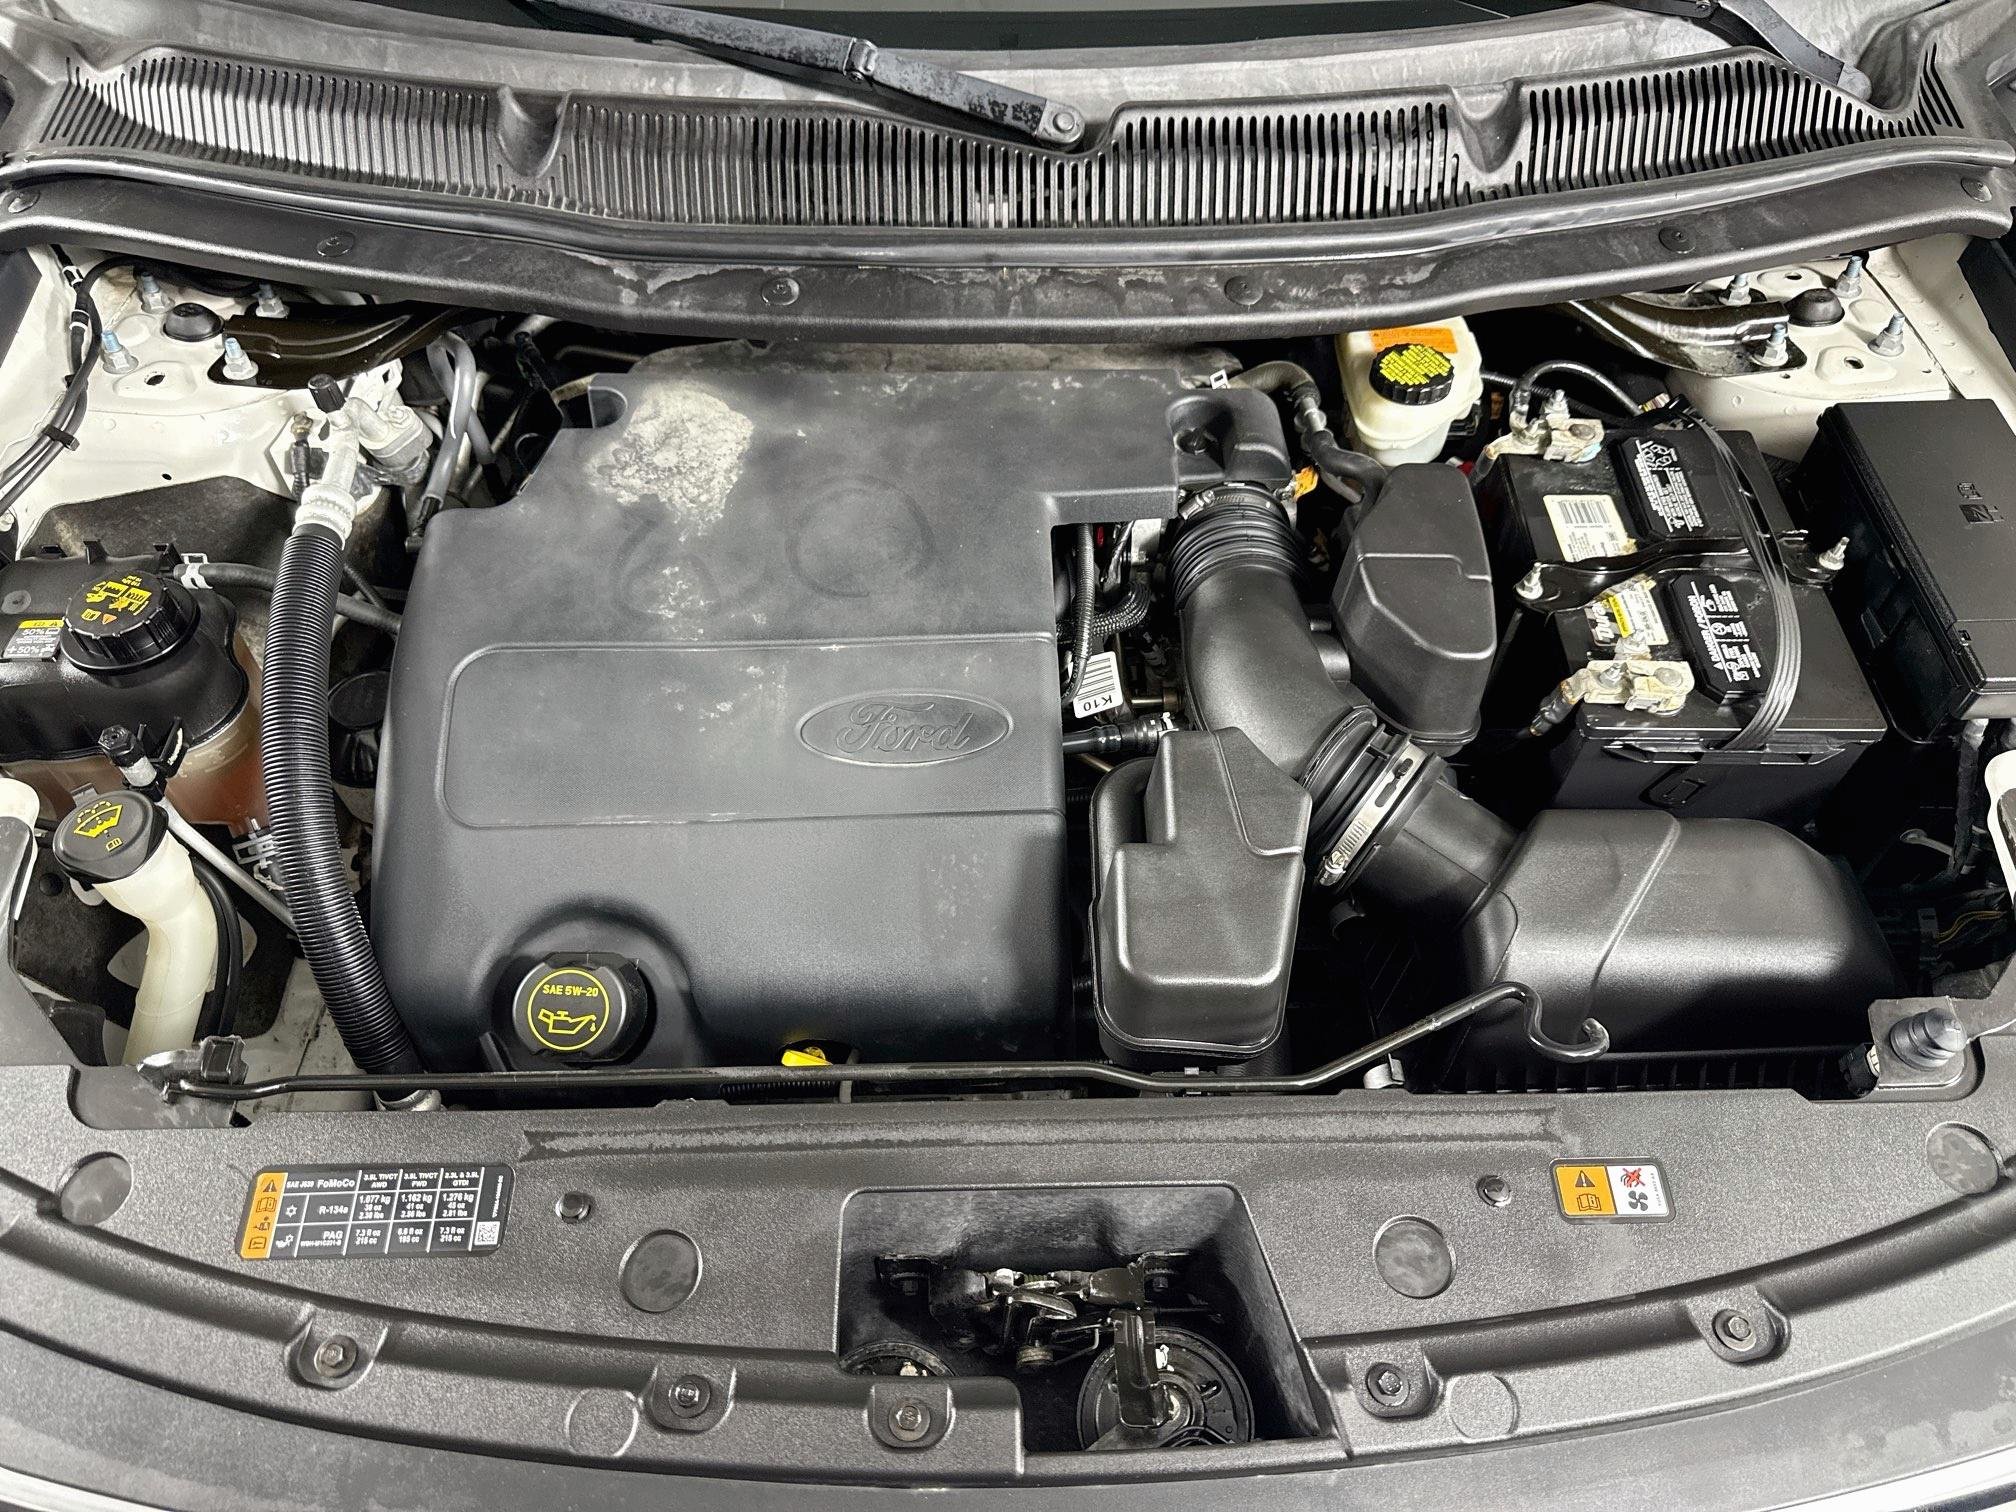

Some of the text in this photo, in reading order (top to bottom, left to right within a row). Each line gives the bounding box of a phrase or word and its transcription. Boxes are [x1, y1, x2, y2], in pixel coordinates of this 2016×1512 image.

[1687, 594, 1706, 623] POISON
[22, 628, 45, 636] 50%
[1701, 629, 1720, 662] DANGER
[1083, 694, 1113, 712] K10
[836, 701, 975, 754] Ford
[542, 984, 599, 997] SAE 5W-20
[286, 1180, 299, 1188] SAE
[317, 1178, 355, 1189] FoMoCo
[360, 1195, 391, 1205] 1.077 kg
[401, 1194, 433, 1203] 1.162 kg
[442, 1193, 474, 1203] 1.276 kg
[319, 1205, 349, 1215] R-134a
[415, 1210, 426, 1218] lbs
[323, 1230, 343, 1240] PAG
[356, 1228, 381, 1237] 7.3 fl oz
[409, 1227, 414, 1235] fl
[450, 1226, 456, 1234] fl
[355, 1236, 368, 1245] 215
